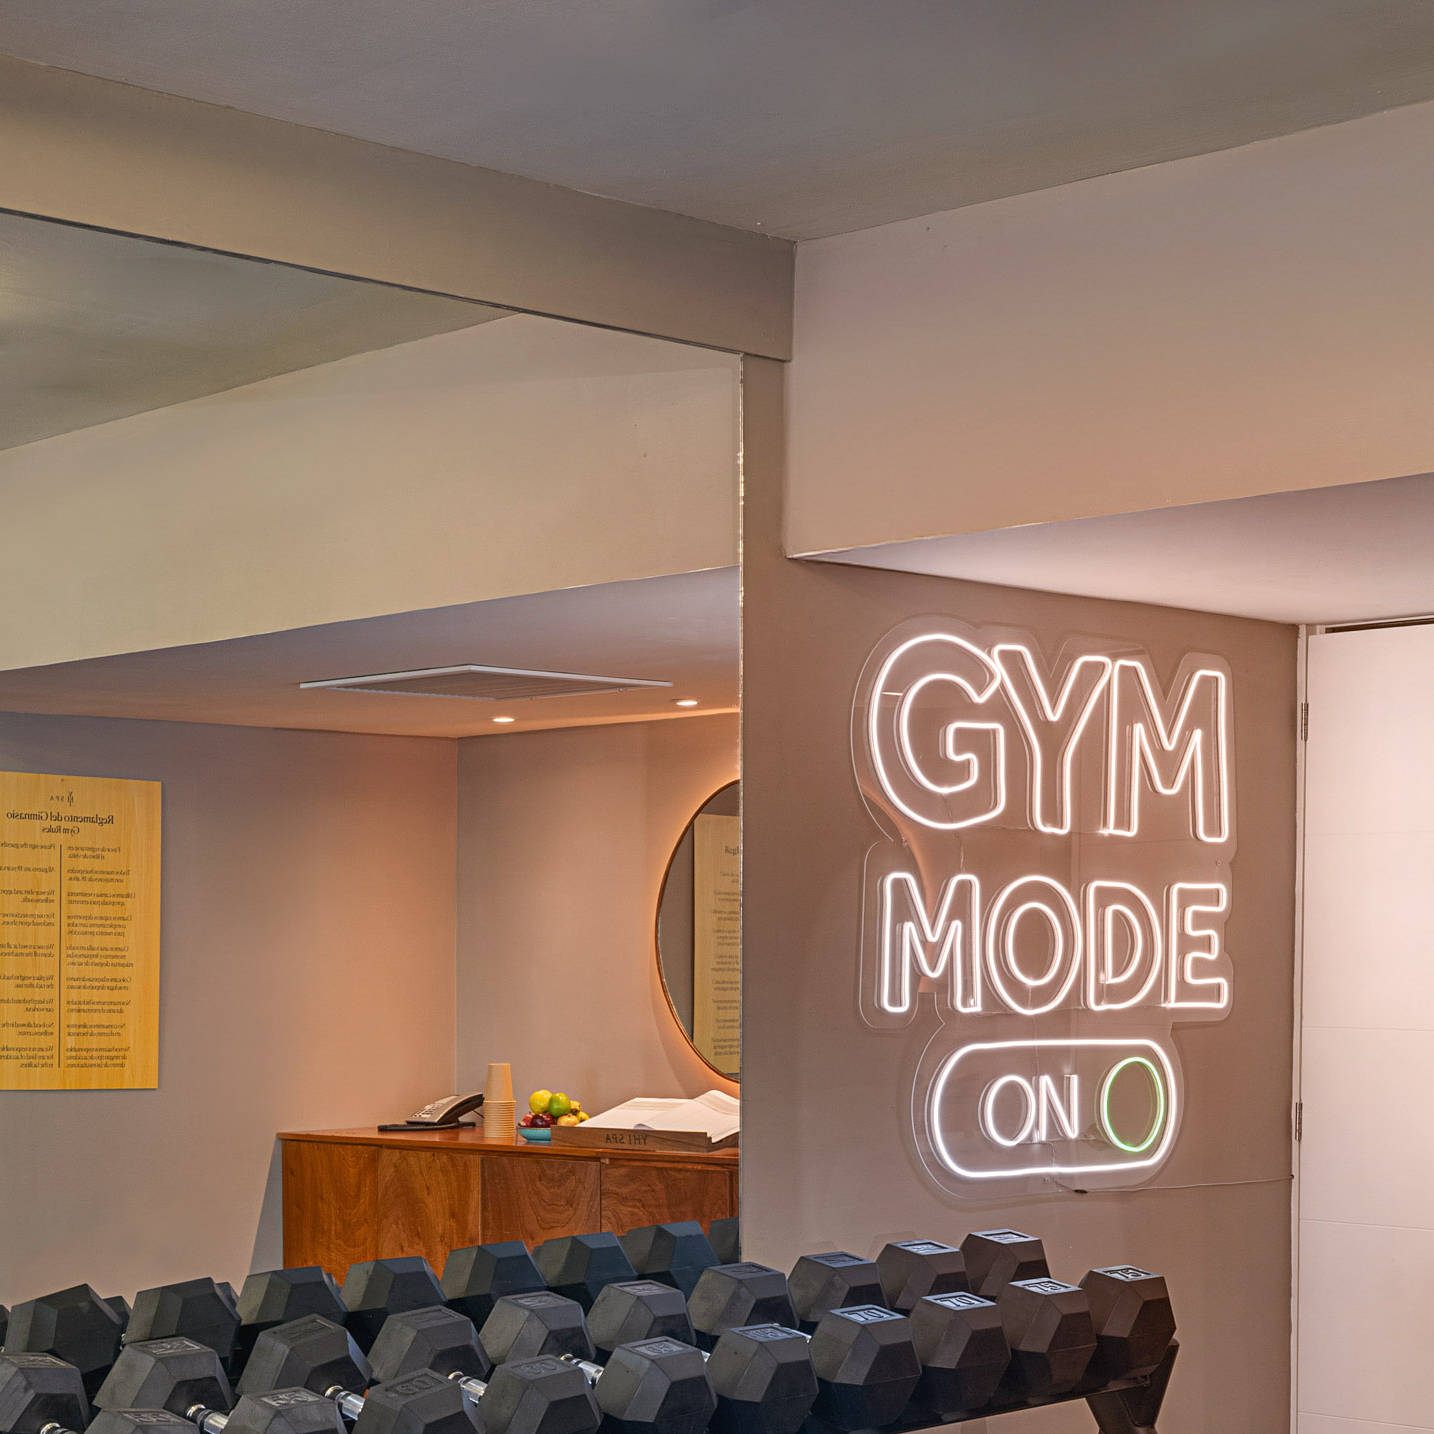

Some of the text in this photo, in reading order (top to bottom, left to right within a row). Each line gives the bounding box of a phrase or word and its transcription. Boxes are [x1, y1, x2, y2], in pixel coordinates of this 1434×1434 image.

[868, 633, 1229, 842] GYM
[880, 872, 1229, 1015] MODE
[984, 1074, 1079, 1146] ON
[1110, 1269, 1143, 1280] 75
[1029, 1283, 1061, 1293] 75
[941, 1298, 974, 1308] 70
[849, 1310, 884, 1321] 70
